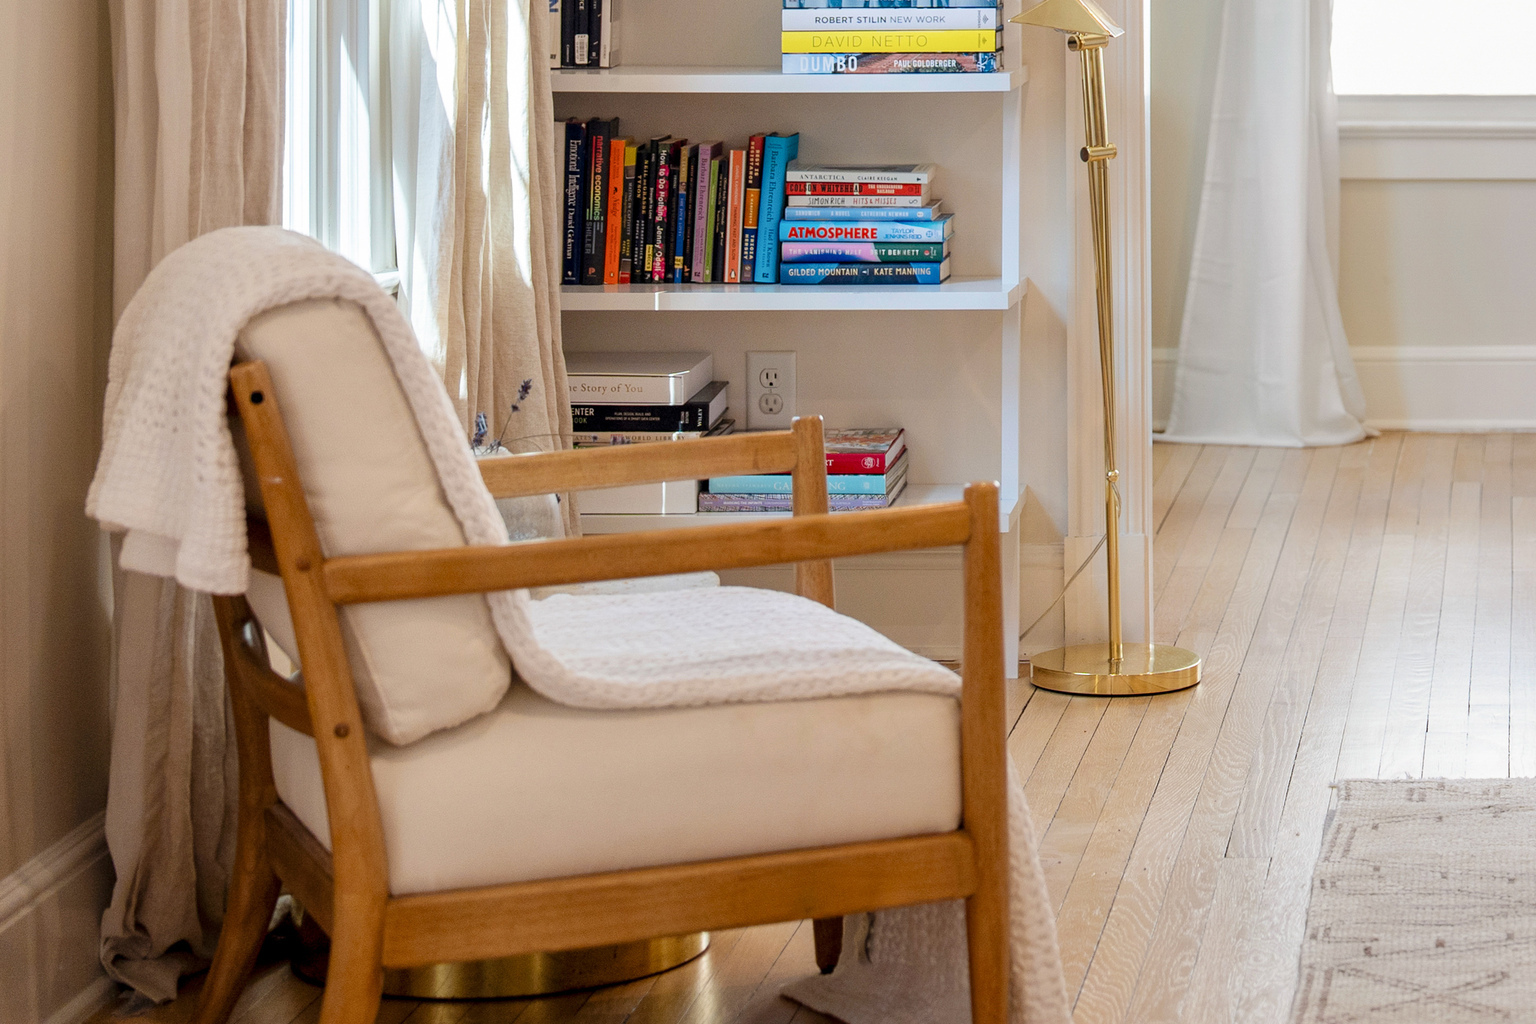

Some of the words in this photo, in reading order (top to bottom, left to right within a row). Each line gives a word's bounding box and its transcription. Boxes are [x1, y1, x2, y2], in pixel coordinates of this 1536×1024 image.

[814, 16, 854, 24] ROBERT
[856, 16, 888, 24] STILIN
[889, 15, 911, 24] NEW
[913, 15, 946, 24] WORK
[812, 35, 863, 48] DAVID
[871, 35, 928, 48] NETTO
[799, 56, 858, 73] DUMBO
[893, 59, 912, 68] PAUL
[912, 59, 957, 68] GOLDBERGER
[568, 138, 582, 173] Emotional
[594, 135, 605, 174] narrative
[659, 149, 668, 166] How
[659, 167, 667, 177] to
[769, 150, 779, 180] Barbara
[565, 173, 580, 207] Intelligence
[658, 178, 667, 190] Do
[789, 184, 817, 193] COLSON
[820, 184, 864, 193] WHITEHEAD
[593, 174, 604, 222] economics
[655, 190, 666, 222] Nothing
[765, 181, 777, 223] Ehrenreich
[566, 207, 574, 229] Daniel
[584, 221, 593, 255] SHILLER
[654, 225, 664, 249] Jenny
[787, 226, 878, 239] ATMOSPHERE
[565, 229, 574, 260] Goleman
[653, 250, 664, 272] Odell
[788, 267, 816, 276] GILDED
[817, 267, 859, 276] MOUNTAIN
[873, 267, 894, 276] KATE
[894, 267, 932, 276] MANNING
[580, 383, 608, 395] Story
[610, 382, 621, 394] of
[622, 384, 644, 394] You
